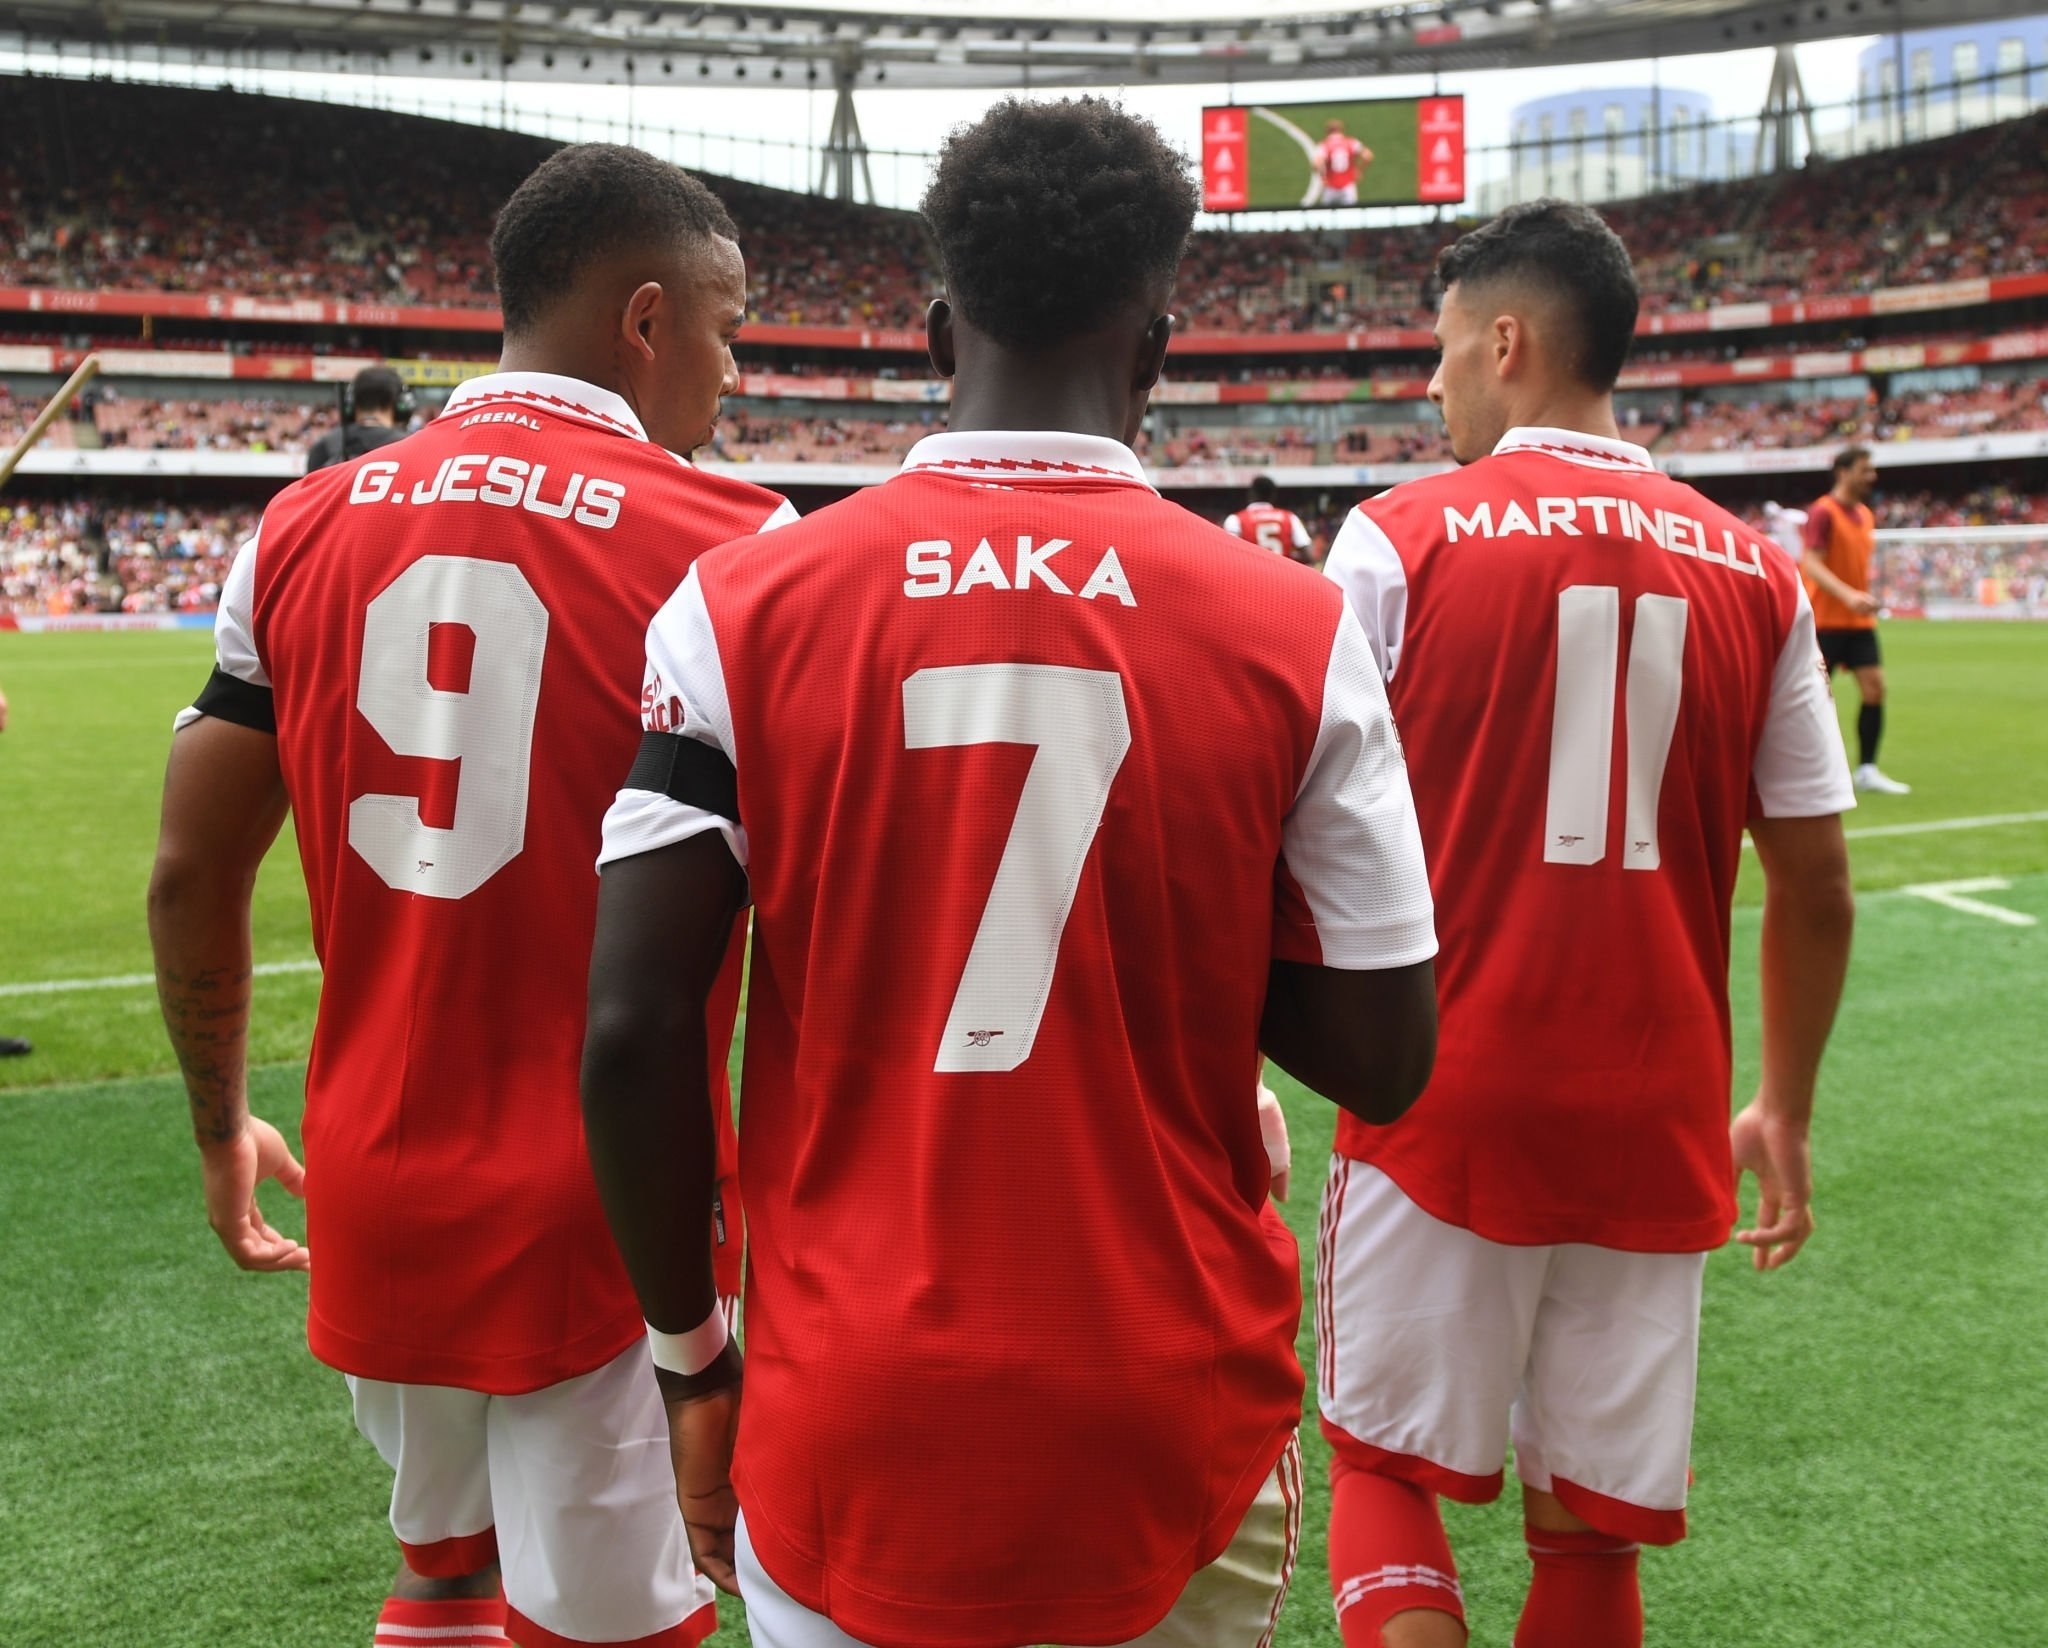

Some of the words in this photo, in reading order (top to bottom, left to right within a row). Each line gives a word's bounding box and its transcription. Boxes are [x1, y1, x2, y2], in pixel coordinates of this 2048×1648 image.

[459, 412, 541, 430] ARSENAL
[348, 454, 626, 529] G.JESUS
[903, 535, 1138, 608] SAKA
[1443, 496, 1767, 579] MARTINELLI
[348, 554, 550, 900] 9
[1543, 584, 1689, 871] 11
[902, 662, 1132, 1073] 7
